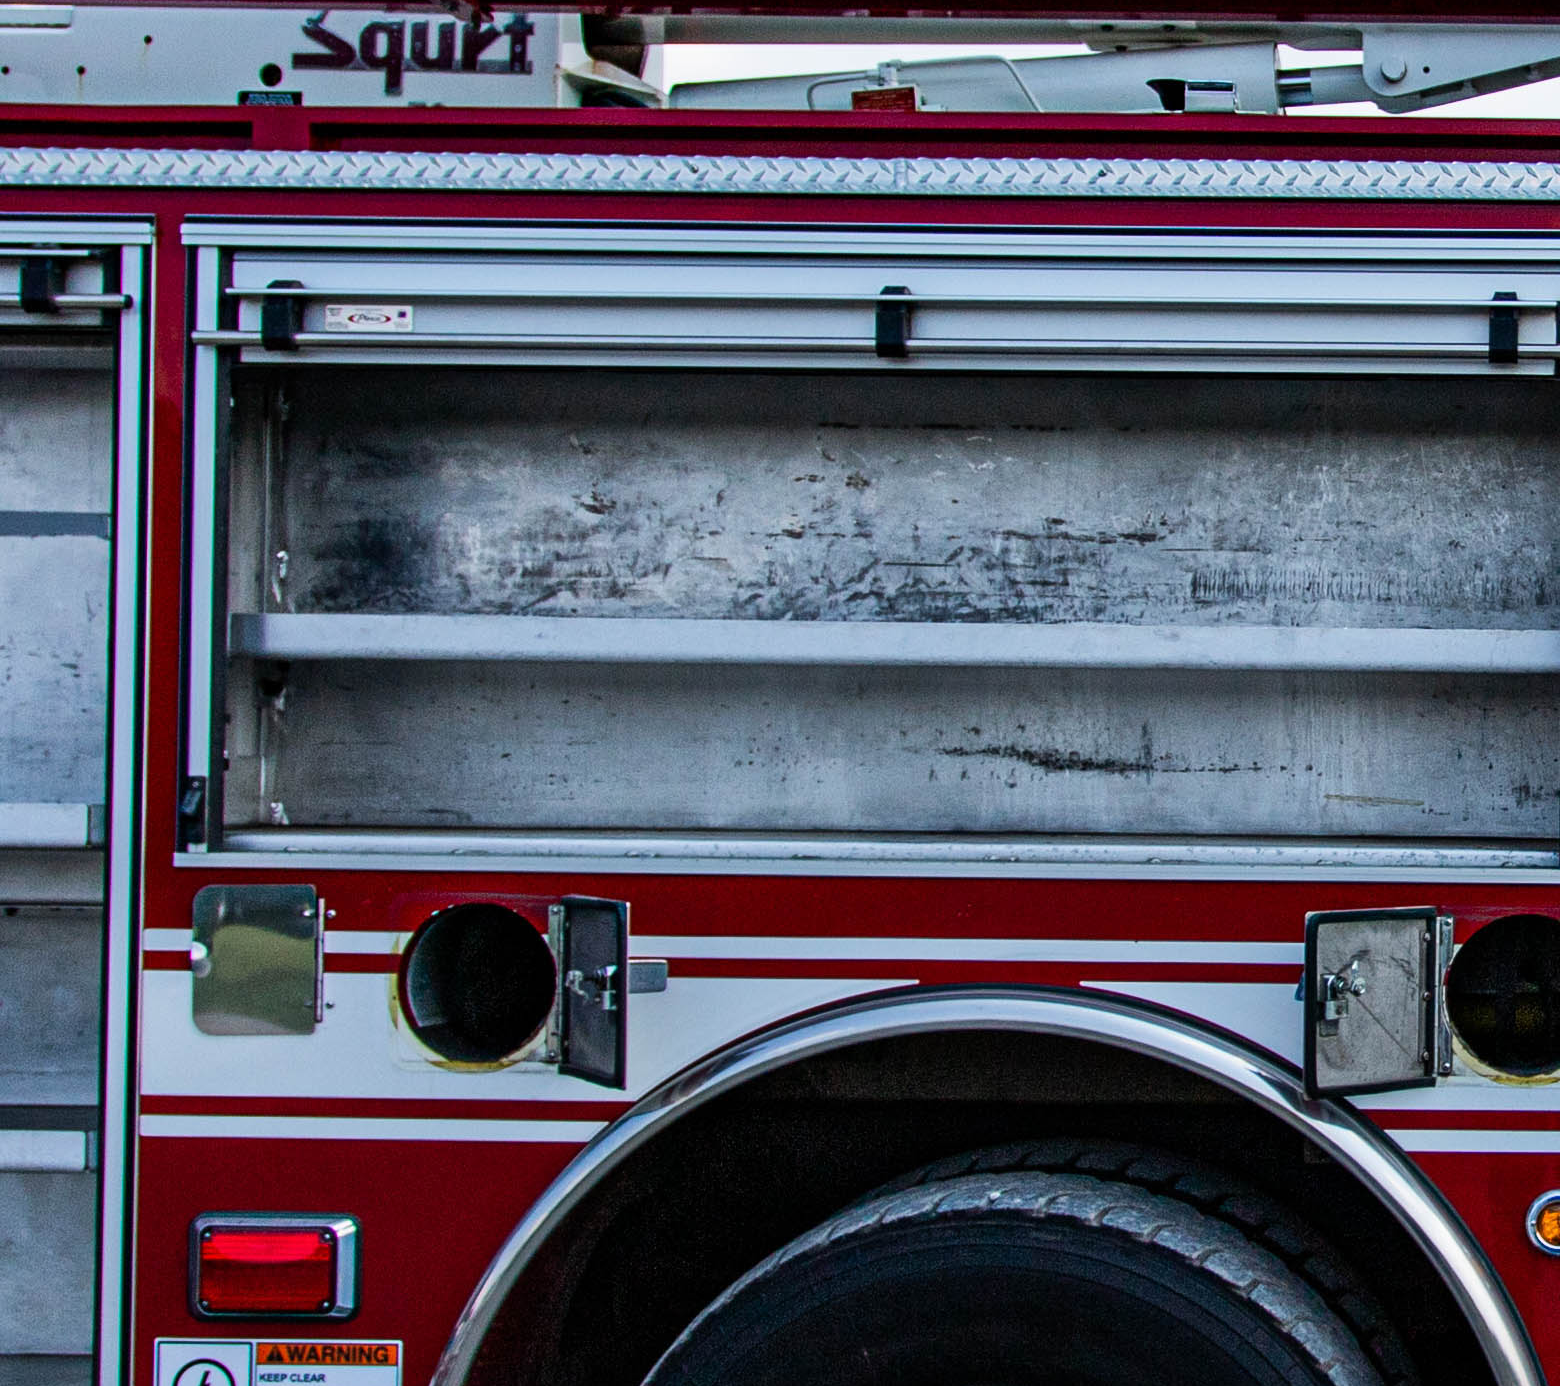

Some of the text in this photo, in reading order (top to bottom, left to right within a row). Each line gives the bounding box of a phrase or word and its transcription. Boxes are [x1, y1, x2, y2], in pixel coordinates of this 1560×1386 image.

[292, 10, 534, 96] Squrt
[286, 1345, 390, 1363] WARNING
[259, 1373, 326, 1382] KEEP CLEAR
